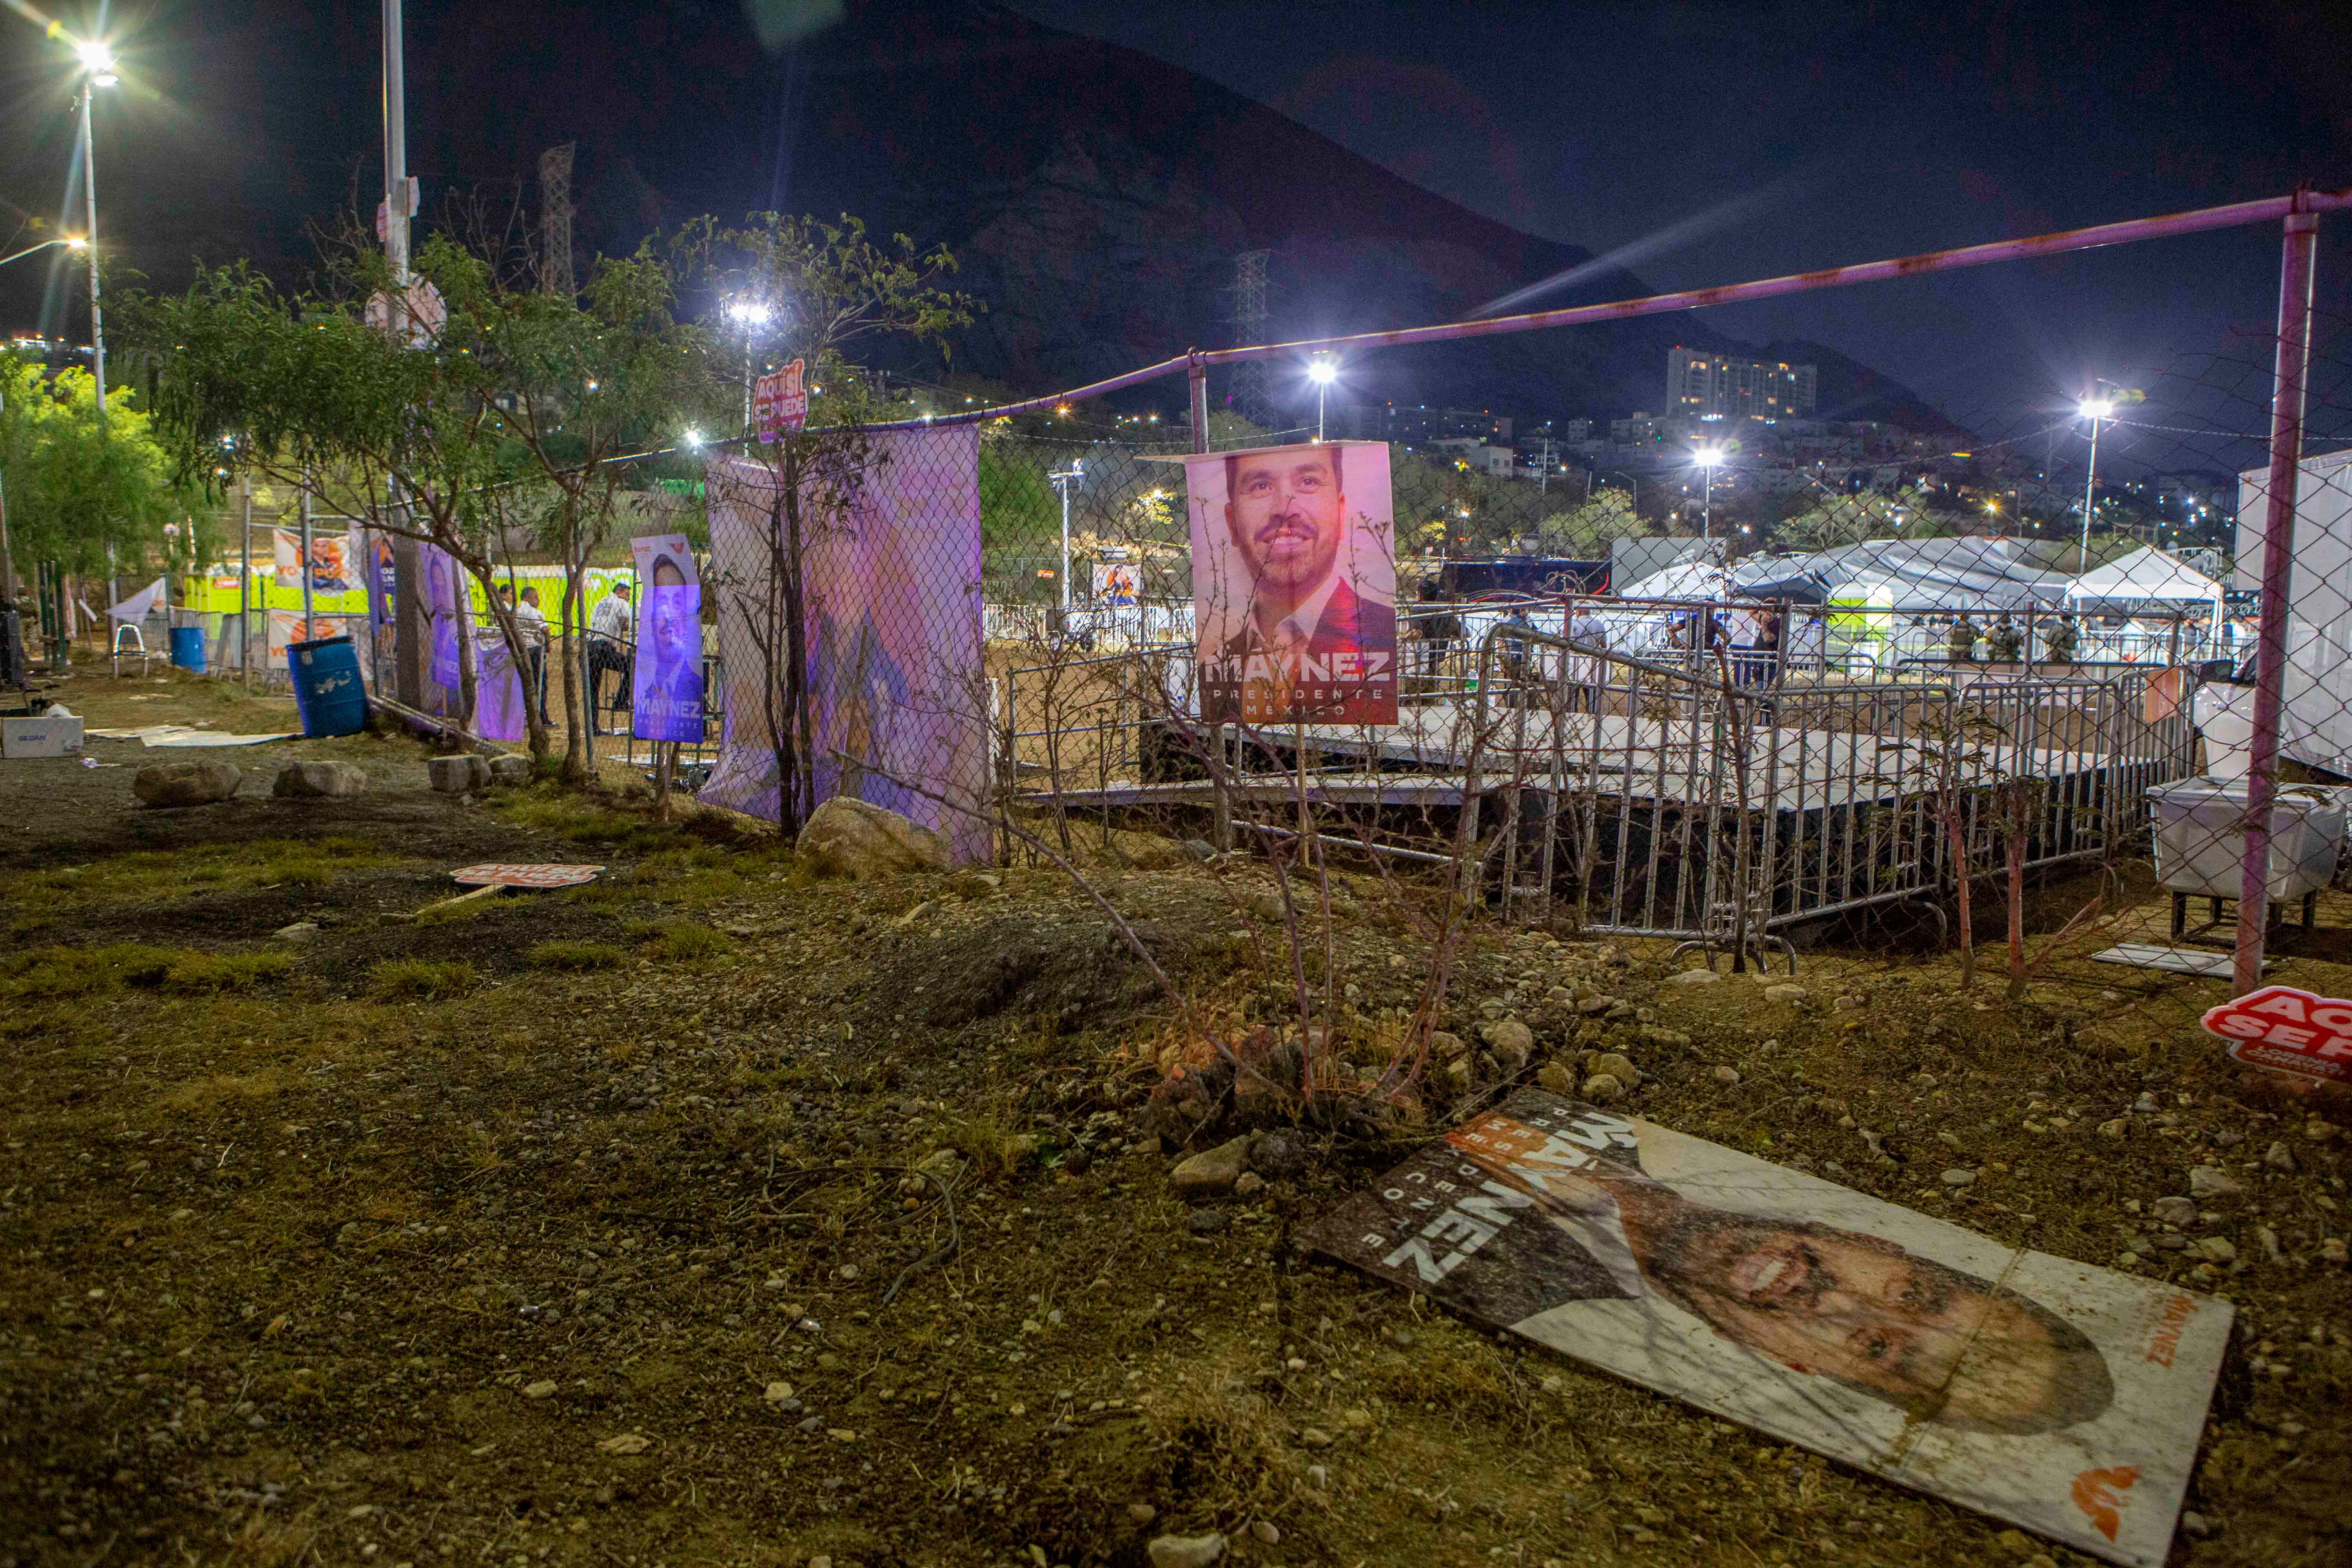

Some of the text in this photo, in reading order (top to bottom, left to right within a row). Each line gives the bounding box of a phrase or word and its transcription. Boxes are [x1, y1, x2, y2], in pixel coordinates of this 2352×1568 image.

[770, 395, 804, 417] PUEDE
[1204, 647, 1390, 682] MÁYNEZ
[1214, 689, 1382, 699] PRESIDENTE
[1361, 1107, 1569, 1247] PRESIDENTE
[1383, 1119, 1509, 1200] MÉXICO
[1383, 1111, 1638, 1283] MÁYNEZ
